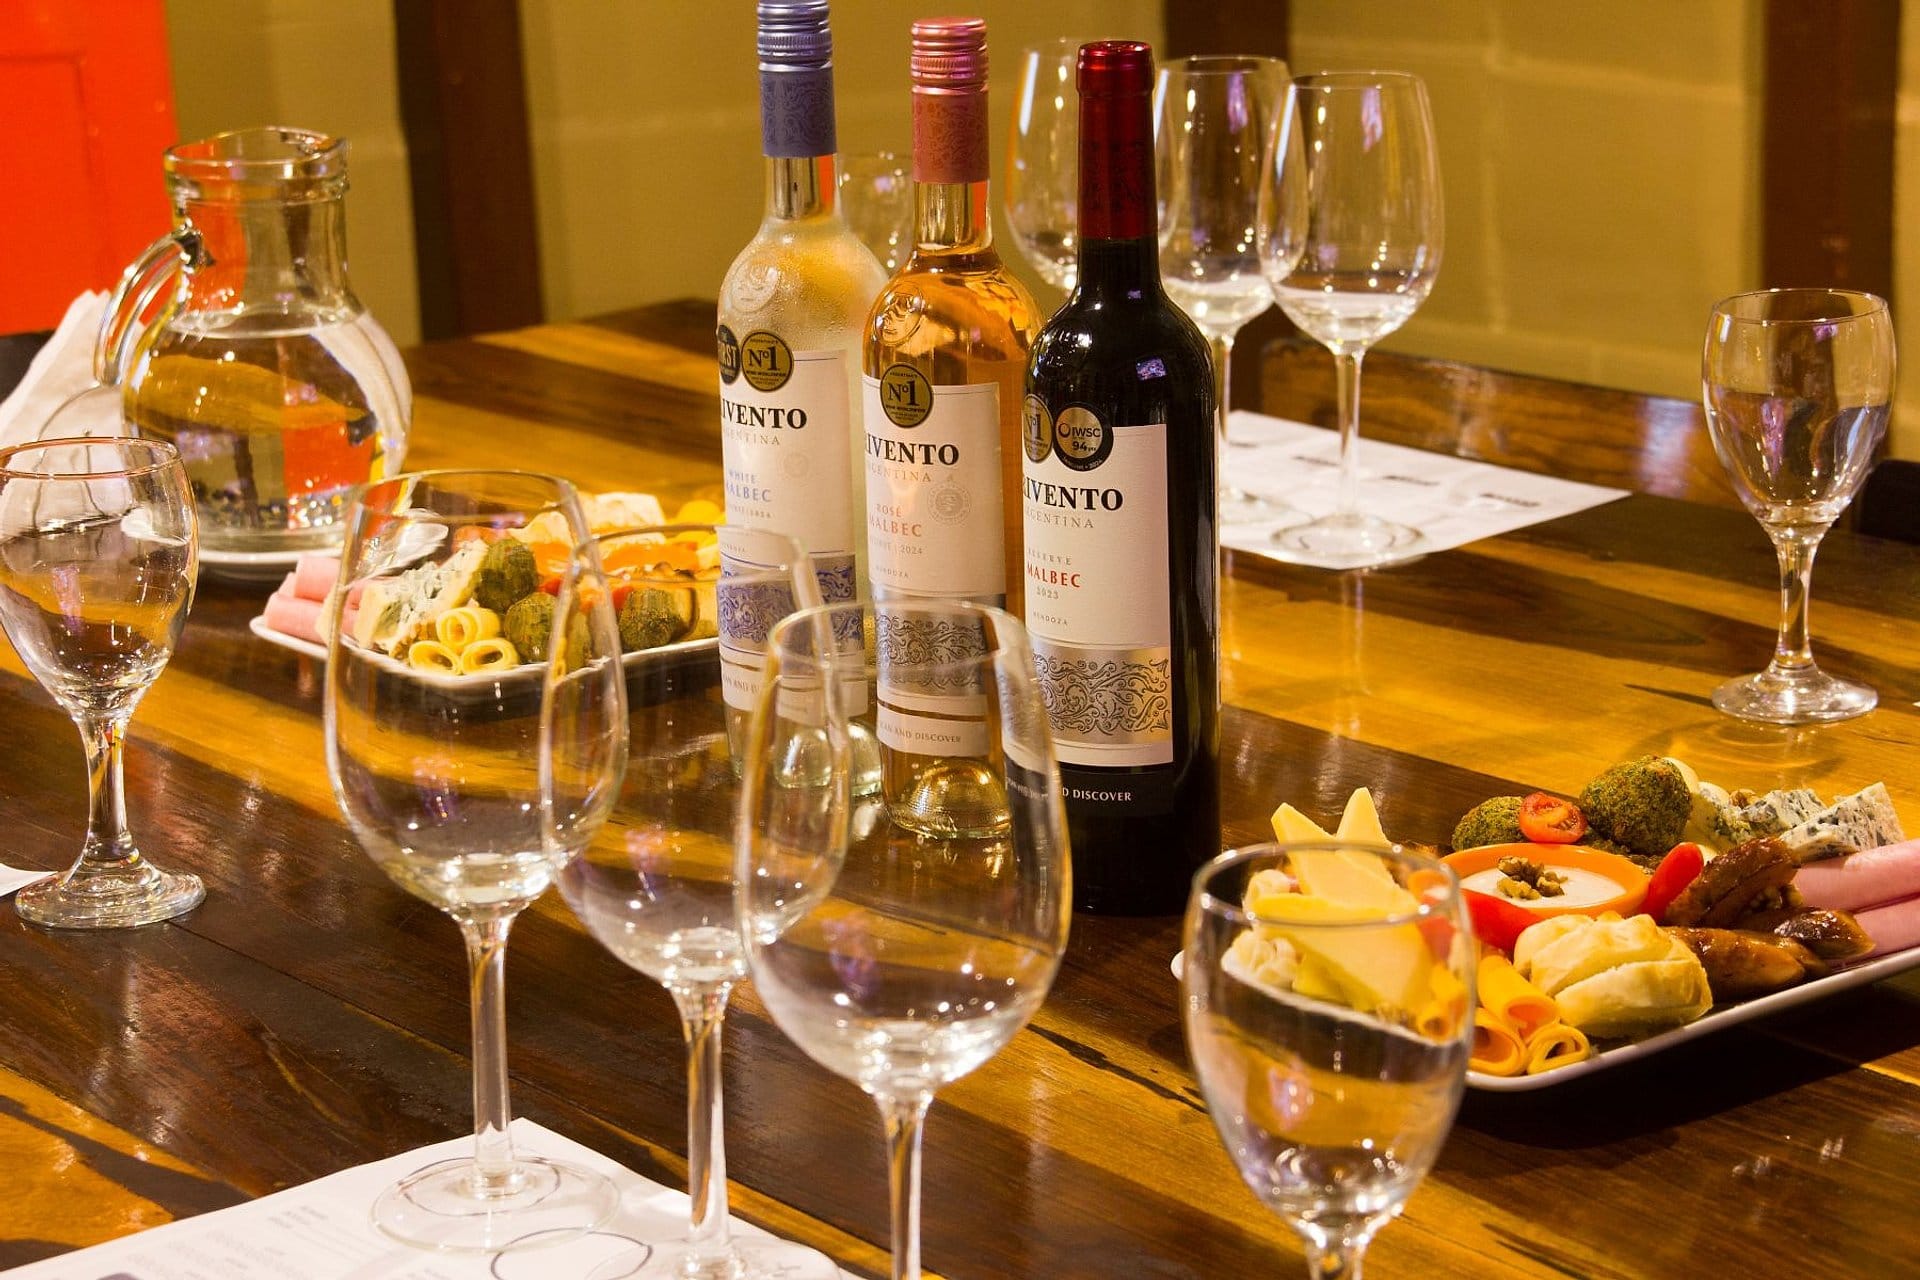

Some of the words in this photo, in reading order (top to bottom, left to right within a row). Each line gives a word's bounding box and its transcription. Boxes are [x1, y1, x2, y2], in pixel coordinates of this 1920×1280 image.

[722, 398, 808, 429] IVENTO
[866, 432, 960, 465] IVENTO
[1027, 562, 1081, 588] MALBEC
[1072, 788, 1132, 802] DISCOVER
